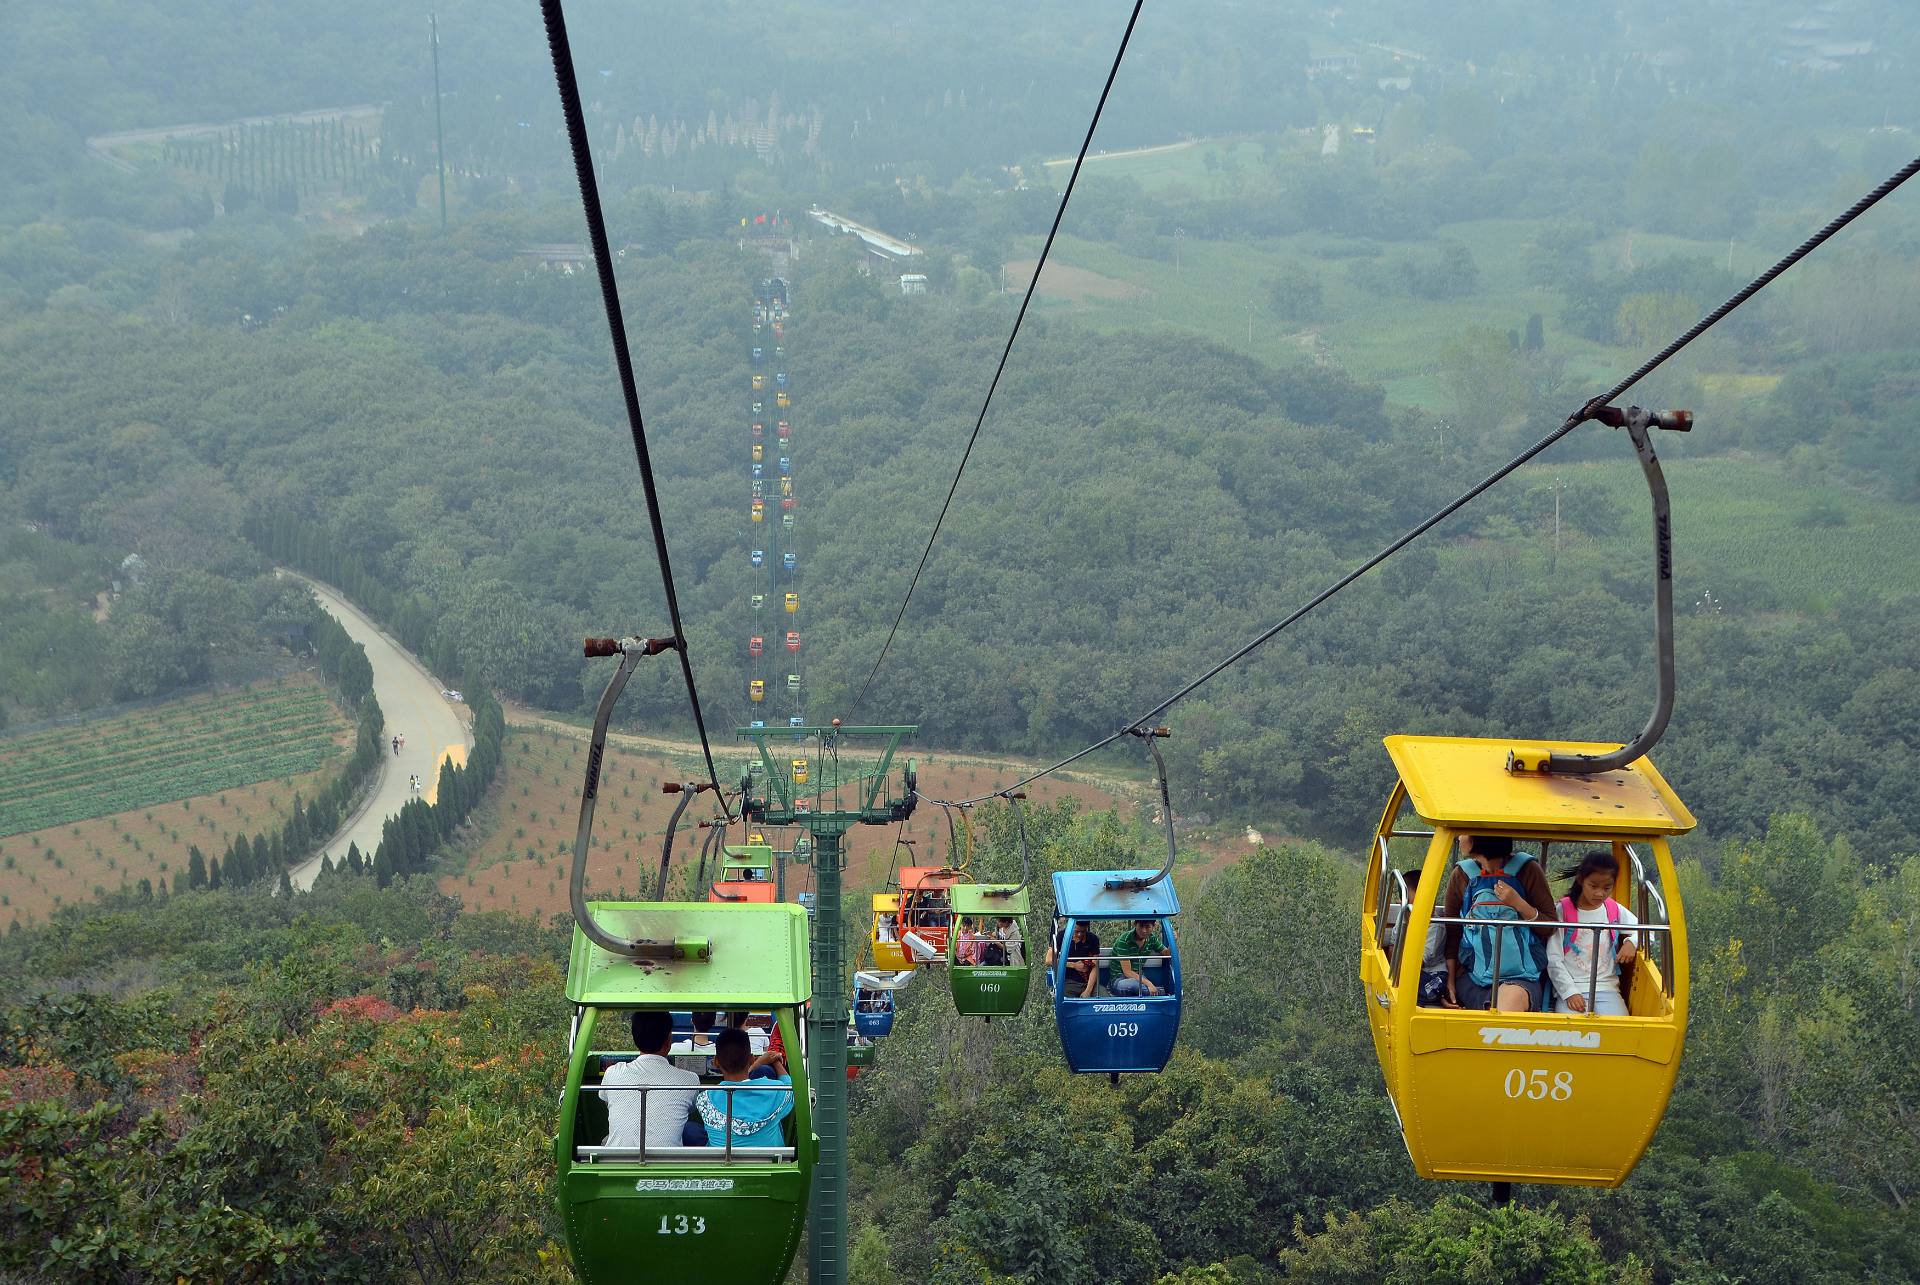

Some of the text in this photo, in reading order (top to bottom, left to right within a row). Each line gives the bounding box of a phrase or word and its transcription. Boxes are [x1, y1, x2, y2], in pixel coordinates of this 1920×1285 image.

[587, 743, 602, 799] TIANMA
[980, 983, 1000, 992] 060
[1093, 1003, 1146, 1012] TIANMA
[1107, 1022, 1139, 1037] 059
[1504, 1068, 1574, 1101] 058
[657, 1214, 706, 1235] 133
